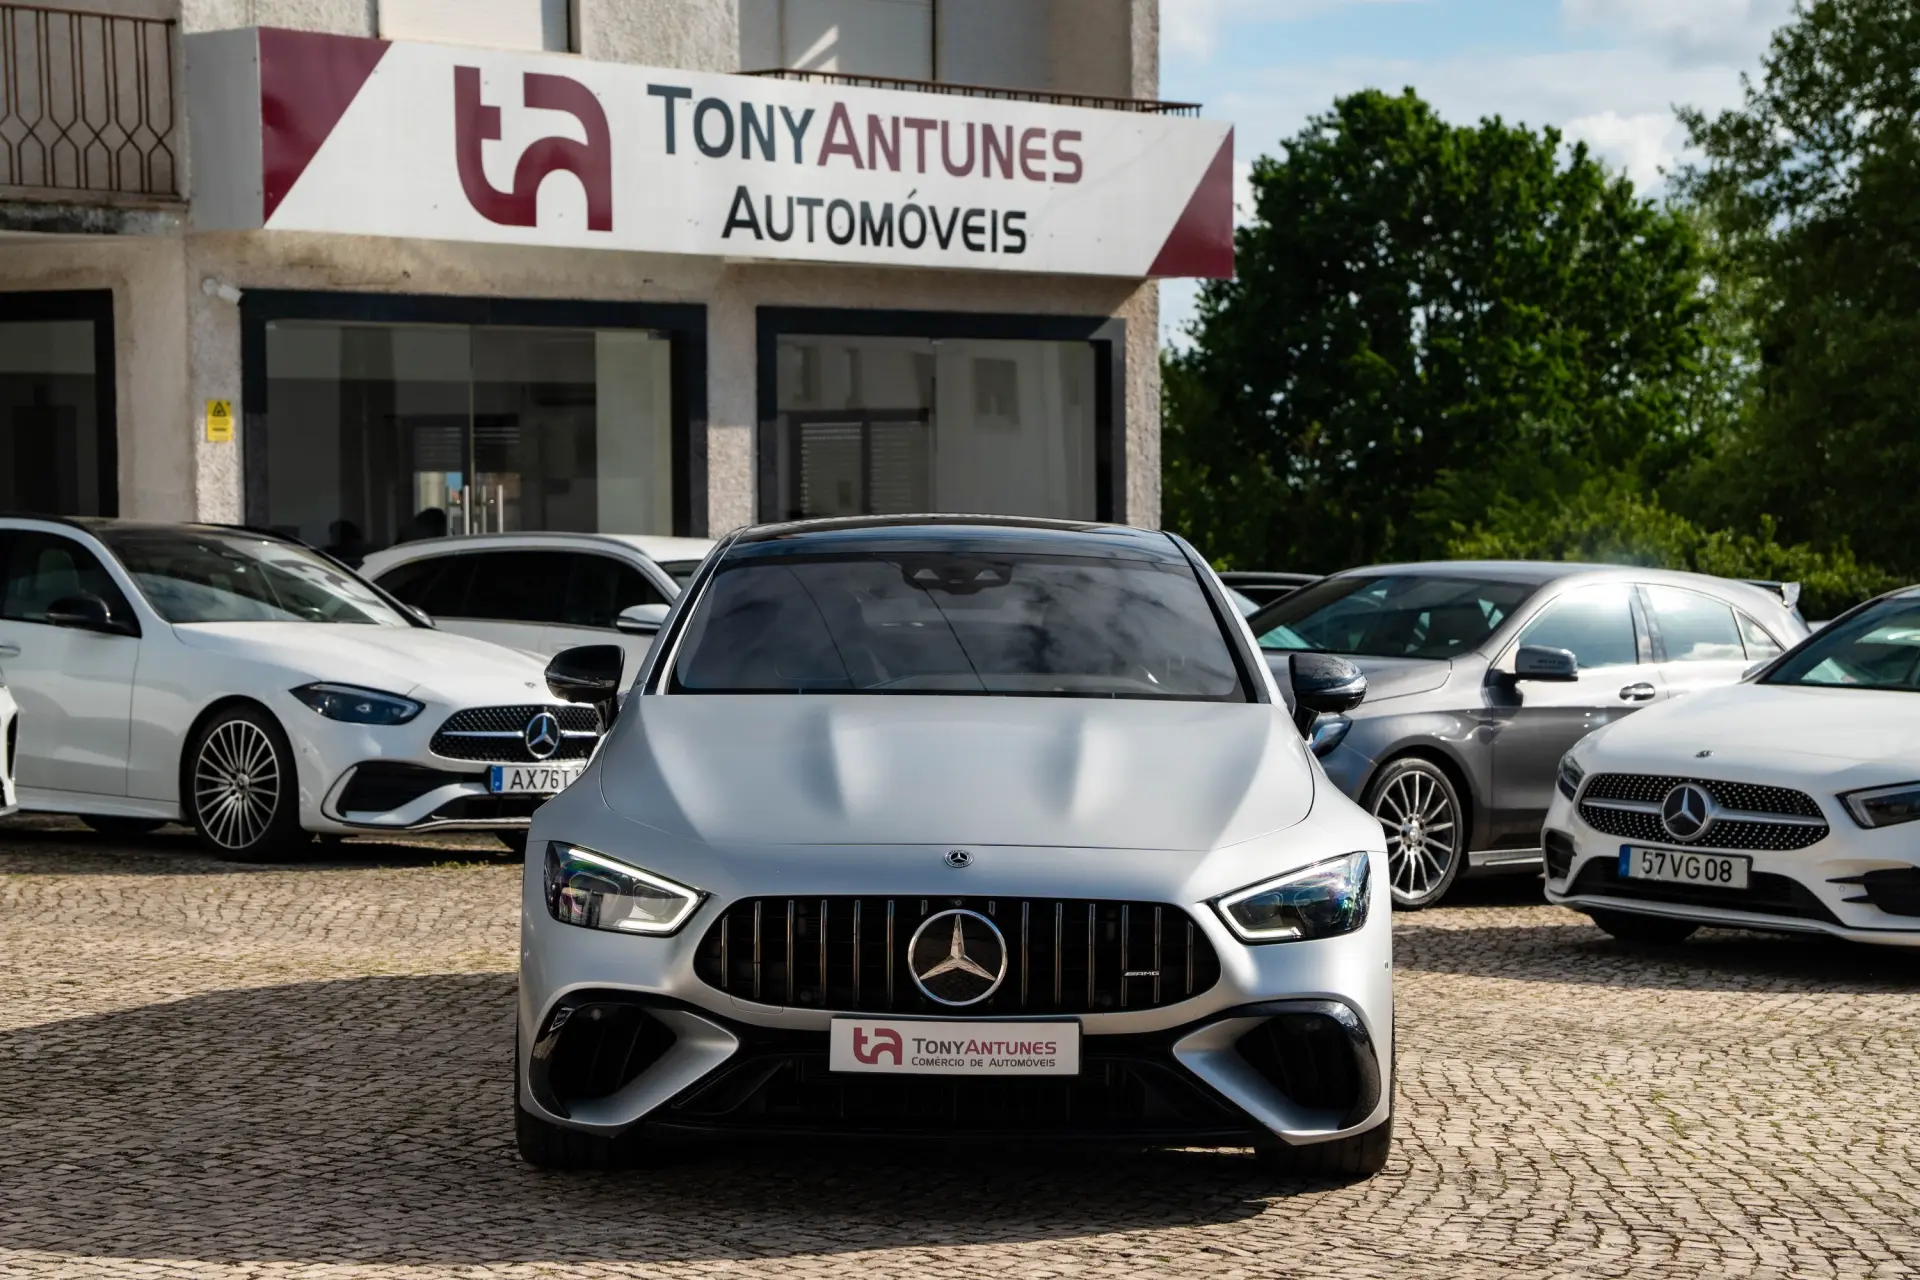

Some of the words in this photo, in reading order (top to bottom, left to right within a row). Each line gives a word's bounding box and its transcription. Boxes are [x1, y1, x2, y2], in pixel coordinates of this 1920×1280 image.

[721, 185, 1027, 254] AUTOMÓVEIS
[1642, 851, 1732, 883] 57VG08
[911, 1056, 965, 1067] COMÉRCIO
[970, 1058, 984, 1067] DE
[989, 1056, 1056, 1067] AUTOMÓVEIS
